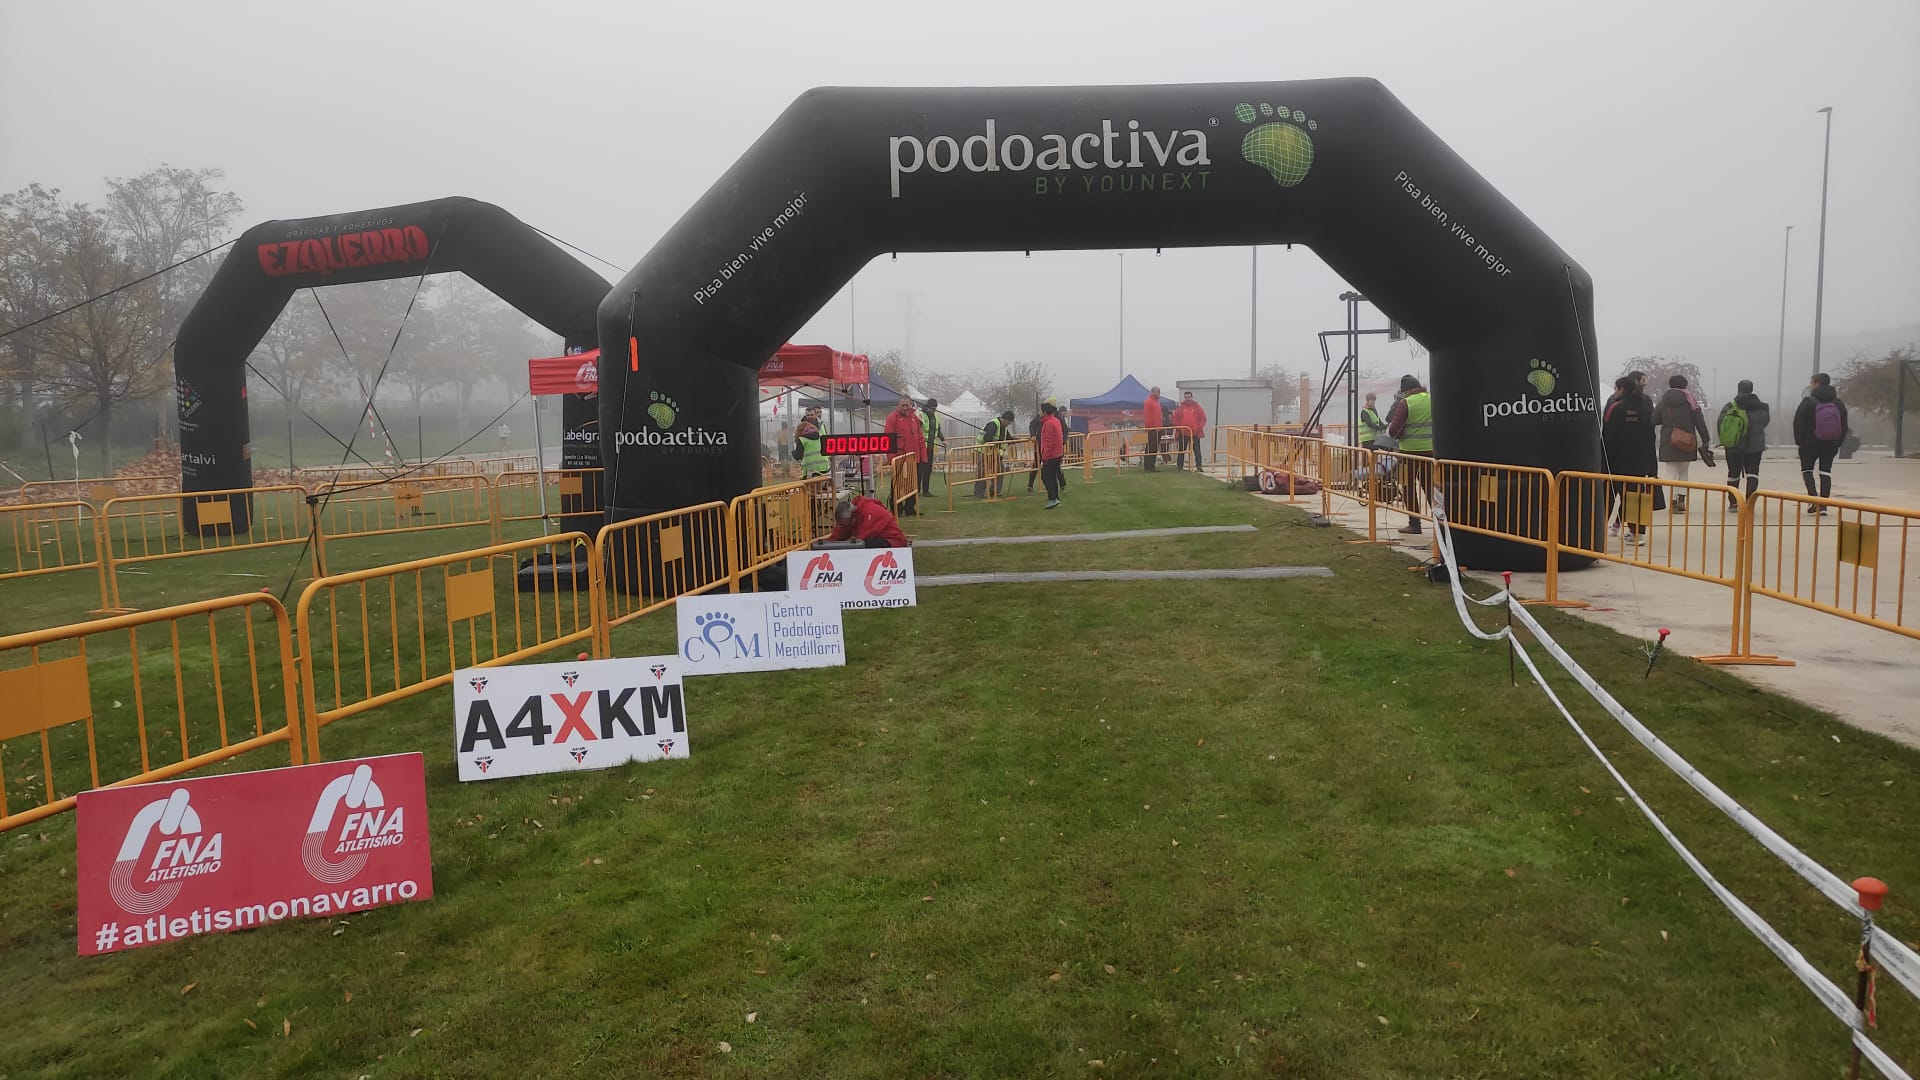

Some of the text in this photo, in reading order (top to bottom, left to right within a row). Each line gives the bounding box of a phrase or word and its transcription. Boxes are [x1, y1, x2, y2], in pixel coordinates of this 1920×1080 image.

[889, 118, 1212, 198] podoactiva
[1034, 171, 1211, 195] BY YOUNEXT
[1394, 170, 1512, 276] Pisa bien, vive mejor
[693, 192, 808, 305] Pisa bien, vive mejor
[766, 361, 784, 369] FNA
[1483, 393, 1595, 427] podoactiva
[615, 425, 728, 455] podoactiva
[816, 572, 843, 584] FNA
[880, 569, 906, 580] FNA
[772, 602, 813, 618] Centro
[774, 621, 839, 639] Podológico
[459, 684, 684, 752] A4XKM
[335, 807, 404, 841] FNA
[151, 832, 223, 870] FNA
[334, 832, 404, 855] ATLETISMO
[145, 859, 222, 883] ATLETISMO
[96, 879, 418, 951] #atletismonavarro
